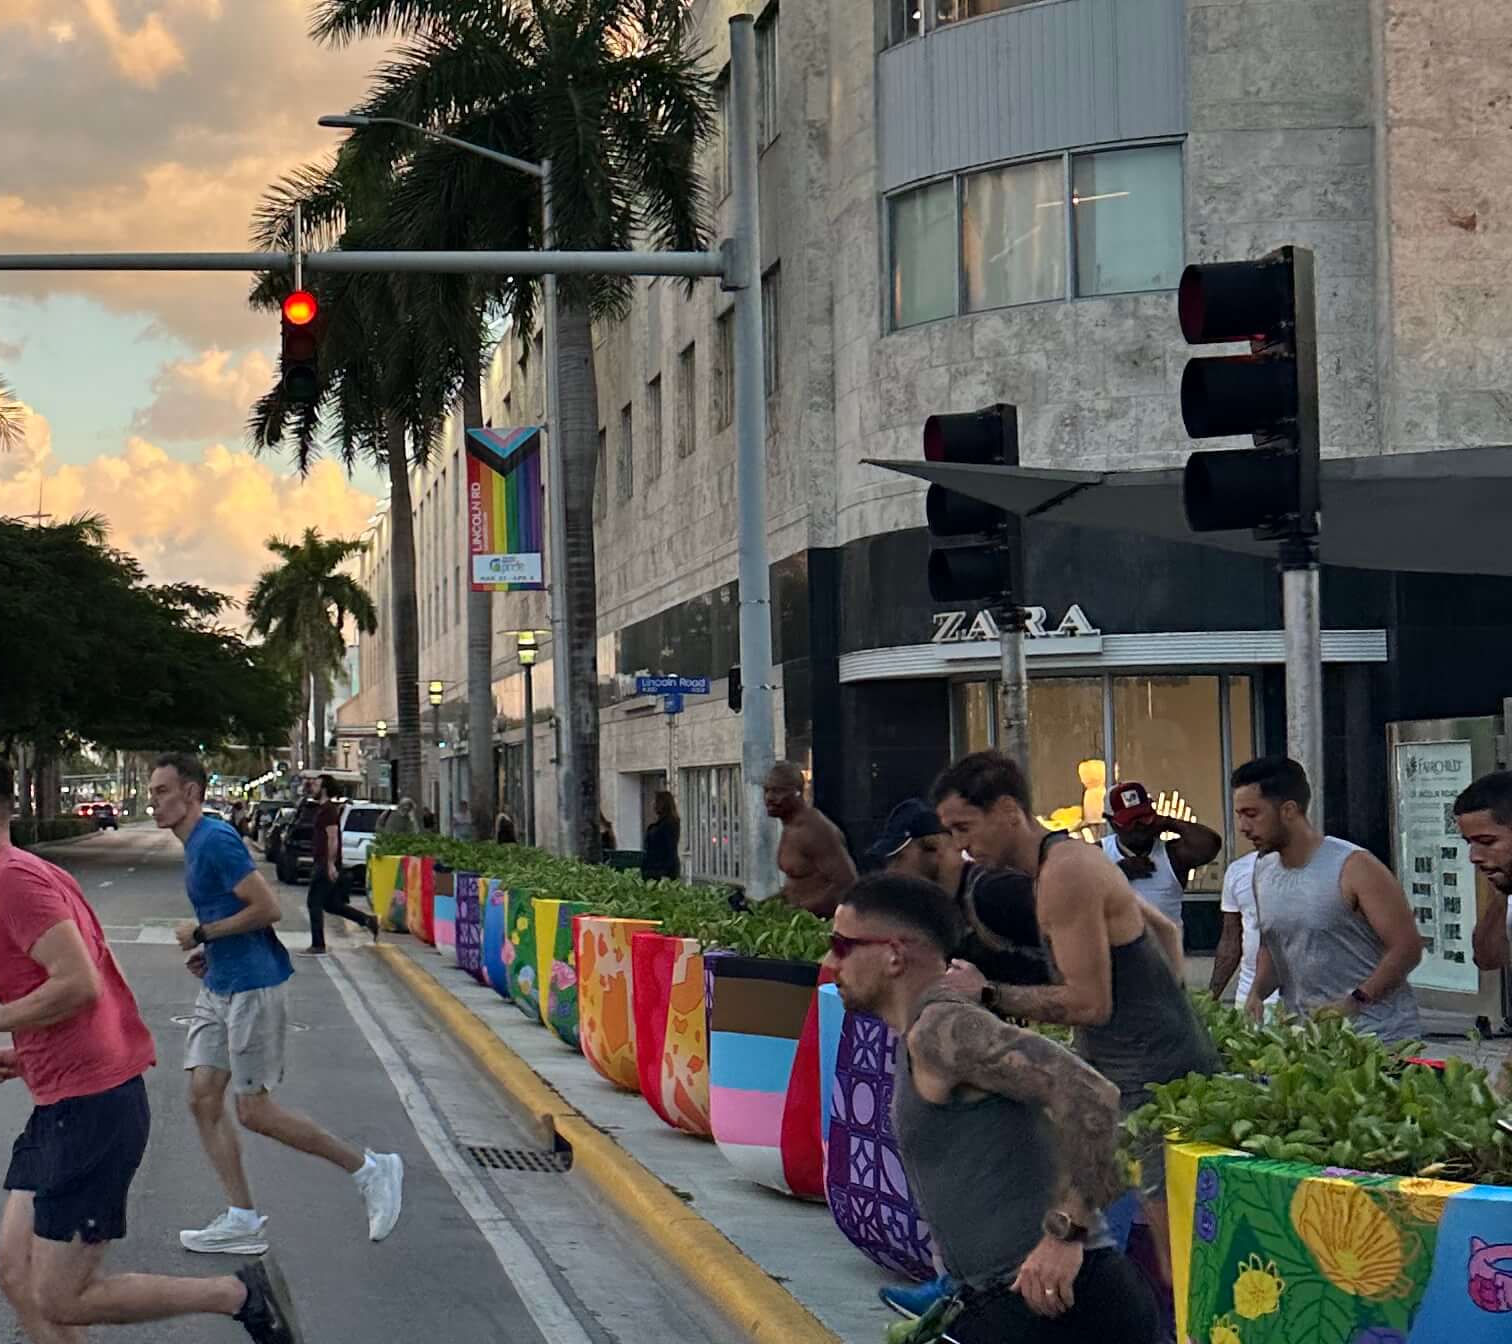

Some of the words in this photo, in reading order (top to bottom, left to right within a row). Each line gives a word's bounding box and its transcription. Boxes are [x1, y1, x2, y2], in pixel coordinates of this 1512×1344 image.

[471, 482, 481, 501] RD
[471, 502, 482, 552] LINCOLN
[932, 604, 1101, 643] ZARA
[641, 678, 677, 688] Lincoln
[680, 678, 706, 688] Road
